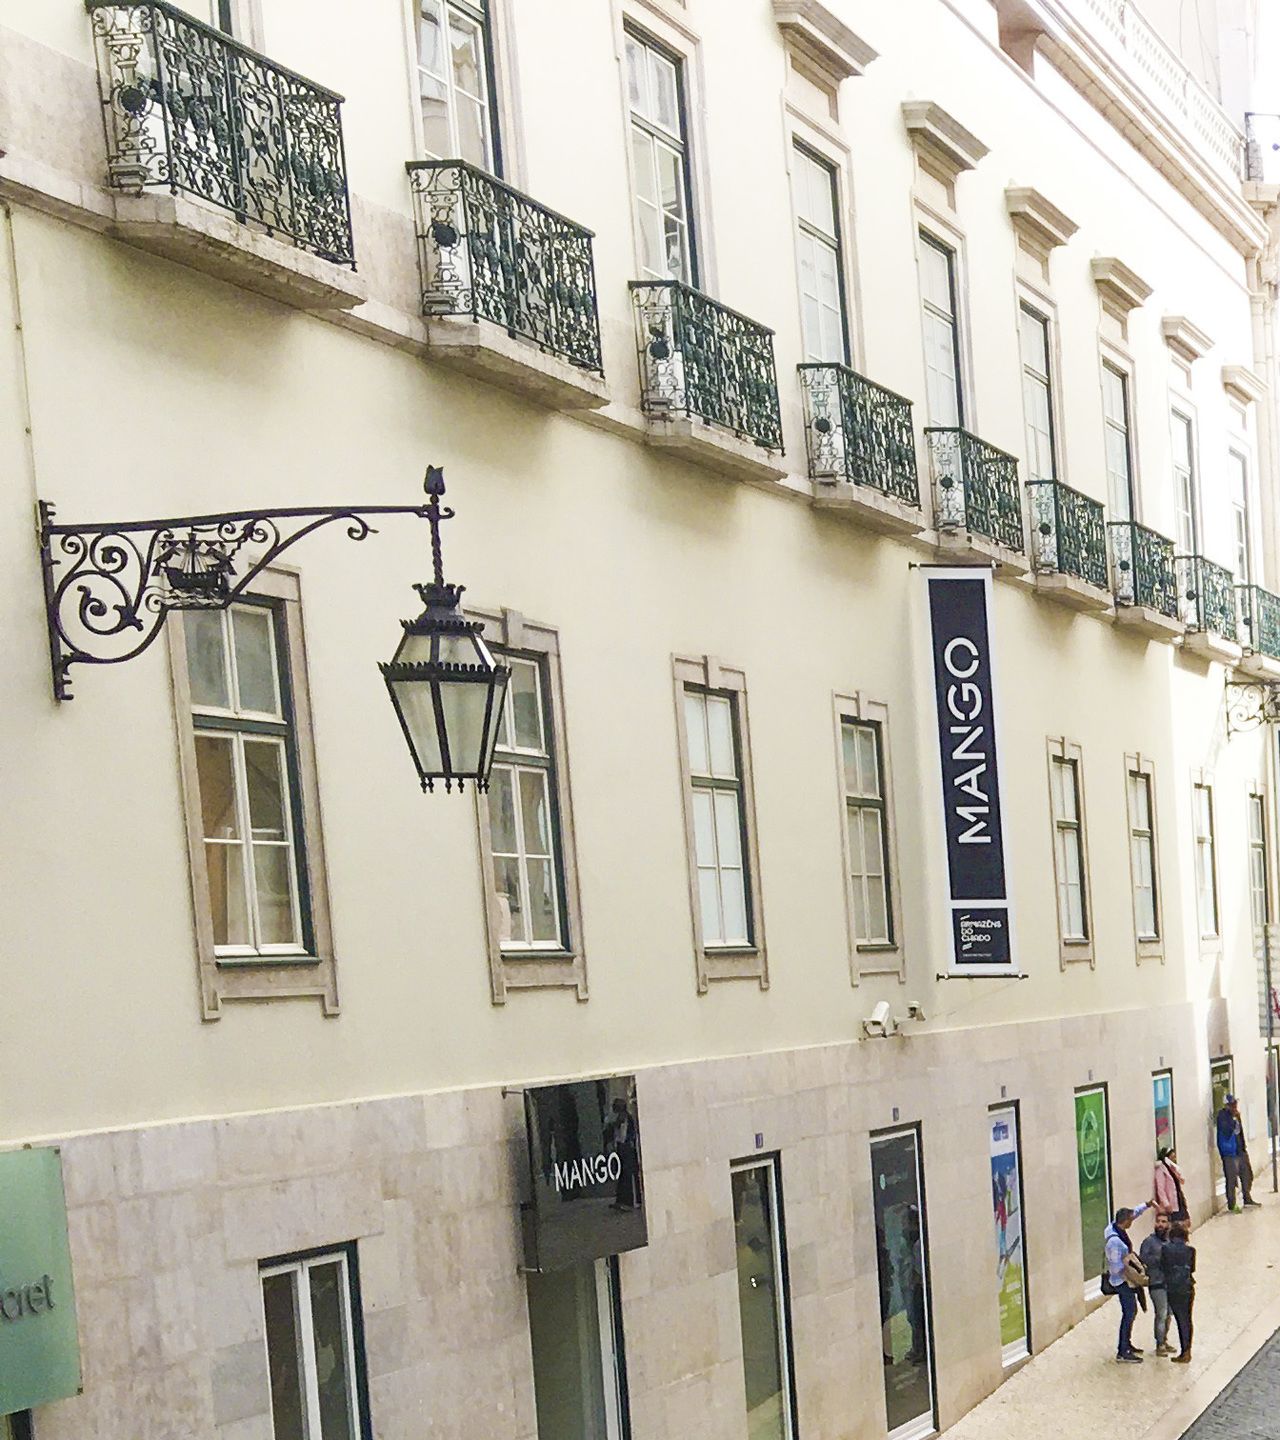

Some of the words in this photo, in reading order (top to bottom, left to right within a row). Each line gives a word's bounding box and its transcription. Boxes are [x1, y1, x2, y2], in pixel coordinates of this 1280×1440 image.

[944, 637, 992, 844] MANGO
[554, 1152, 621, 1192] MANGO
[0, 1273, 55, 1321] cret
